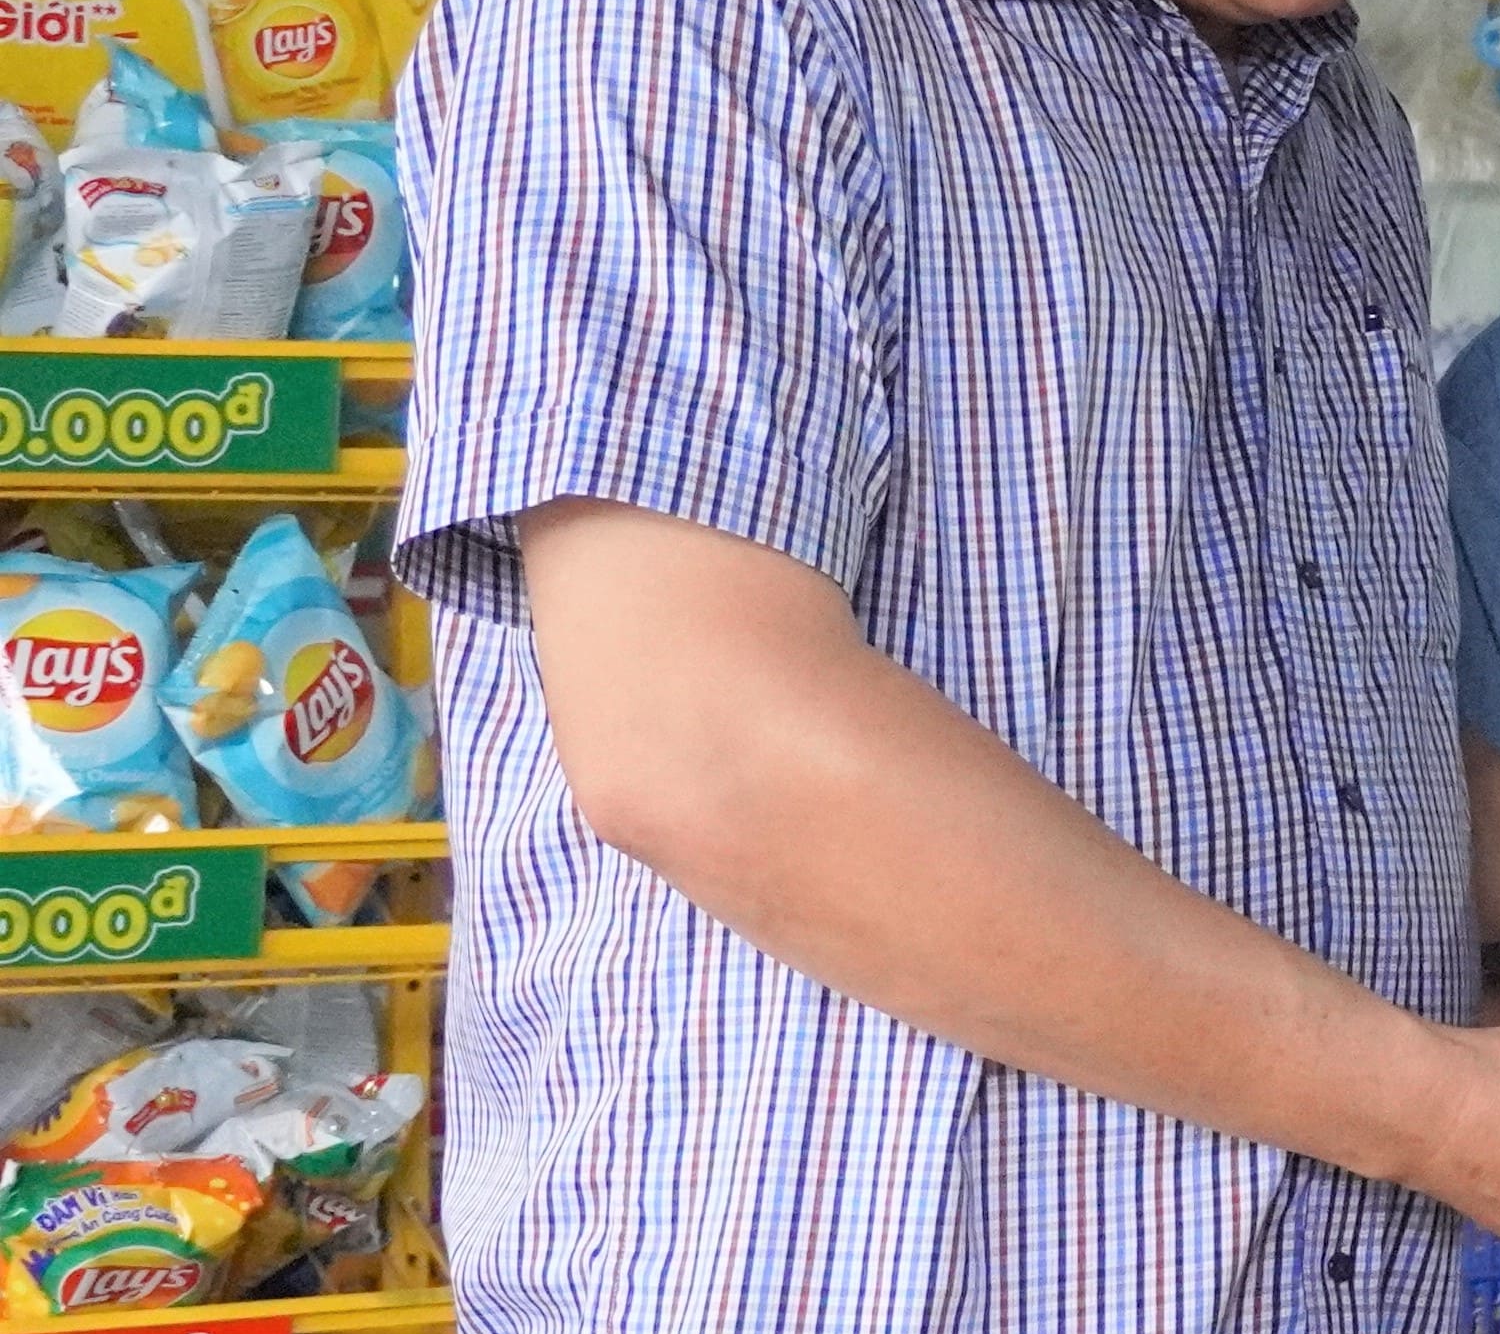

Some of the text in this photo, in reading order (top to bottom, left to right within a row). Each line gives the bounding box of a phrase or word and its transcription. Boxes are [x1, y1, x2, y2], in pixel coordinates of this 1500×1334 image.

[257, 14, 337, 66] Lay's
[8, 634, 139, 707] Lay's
[292, 646, 368, 756] Lay's
[66, 1264, 195, 1307] Lay's
